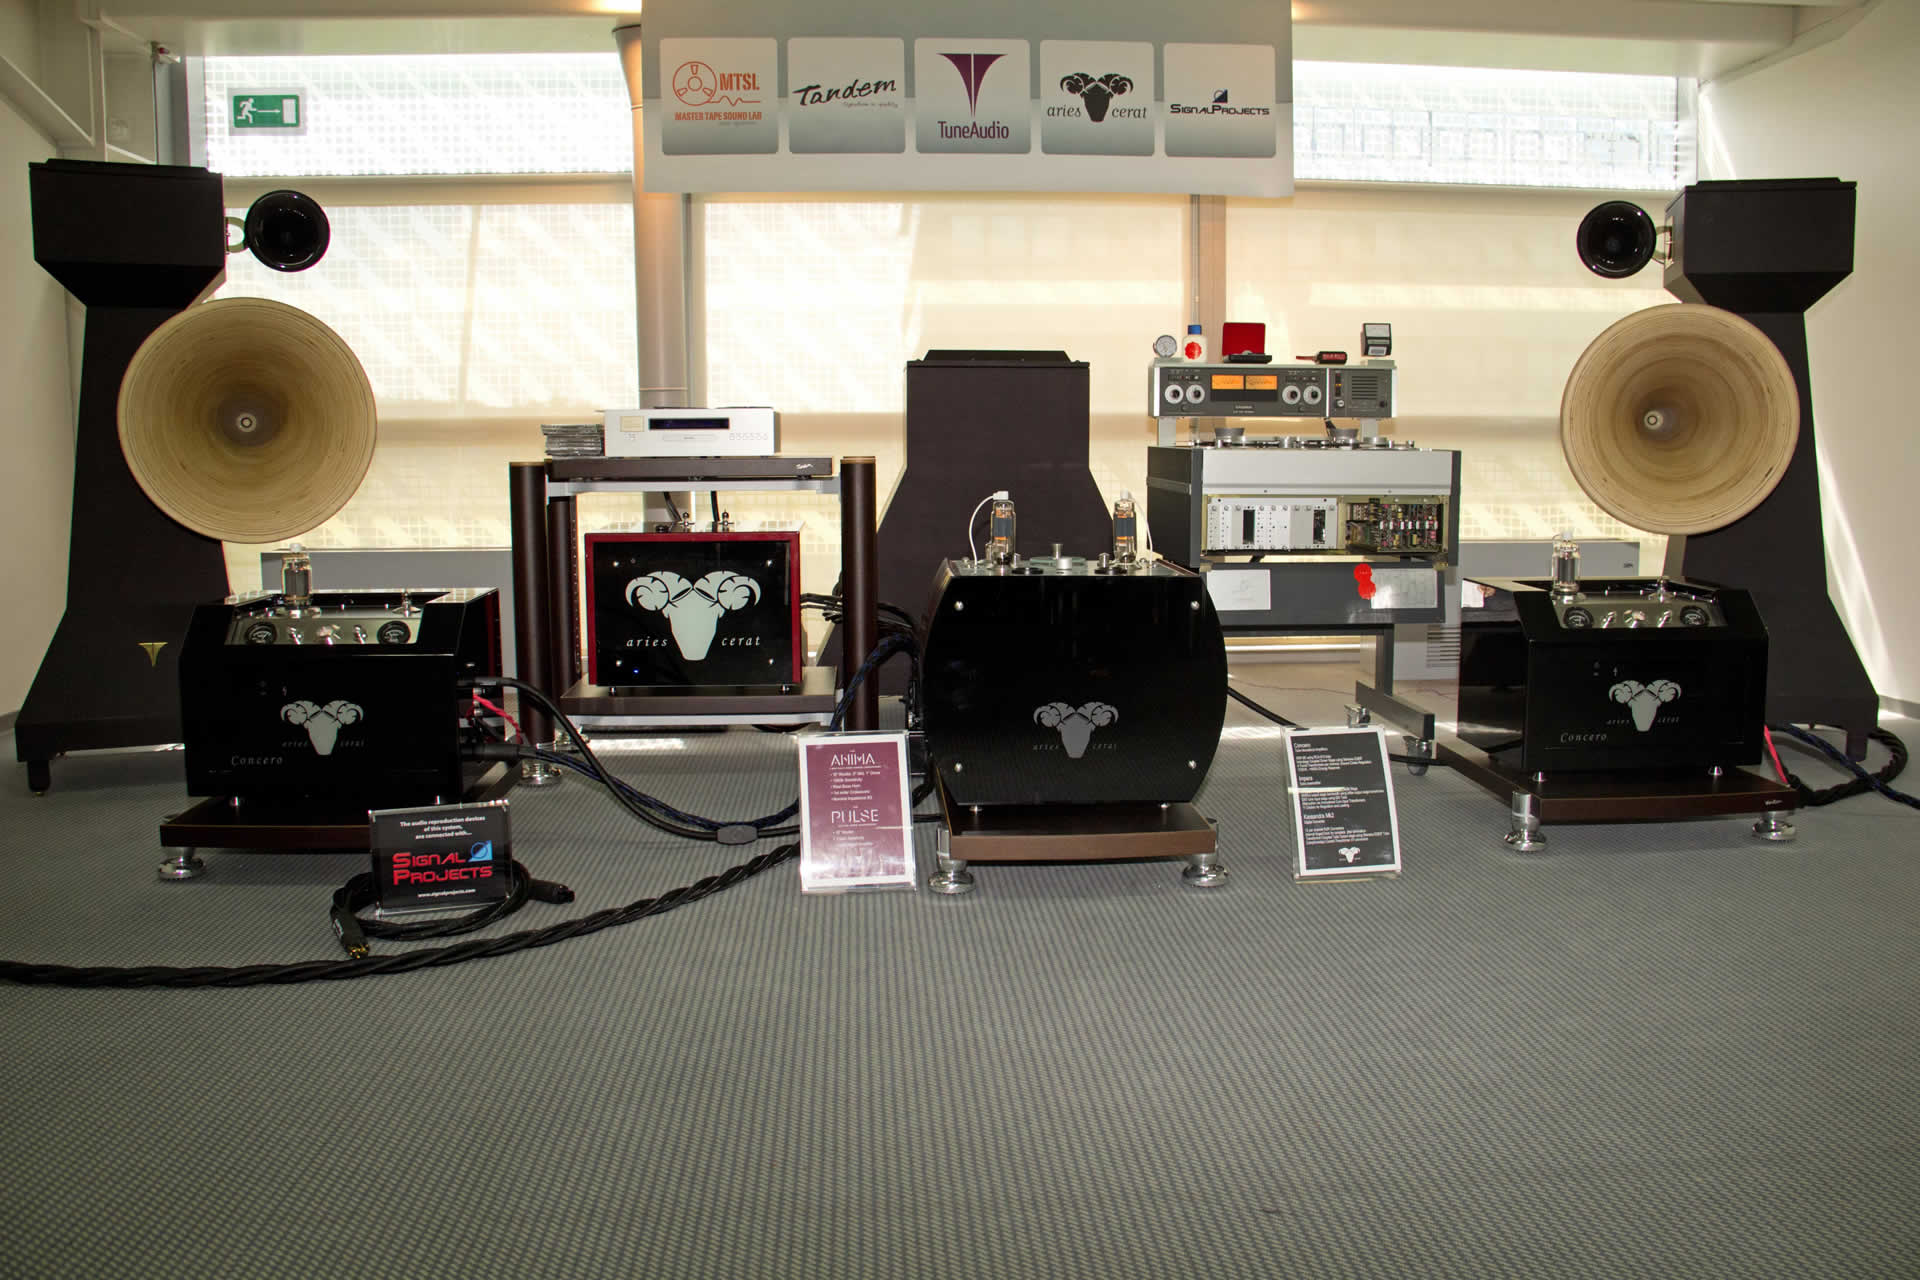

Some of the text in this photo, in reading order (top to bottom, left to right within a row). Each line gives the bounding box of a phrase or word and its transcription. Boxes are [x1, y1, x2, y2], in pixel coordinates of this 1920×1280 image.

[719, 72, 760, 91] MTSL
[792, 79, 896, 106] Tandem
[674, 112, 762, 121] MASTER TAPE SOUND LAB
[1047, 104, 1147, 118] aries cerat
[937, 120, 1010, 140] TuneAudio
[626, 635, 761, 647] aries cerat
[1560, 732, 1607, 743] Concero
[231, 755, 283, 767] Concero
[831, 753, 875, 765] ANIMA
[428, 817, 465, 826] reproduction
[831, 809, 879, 824] PULSE
